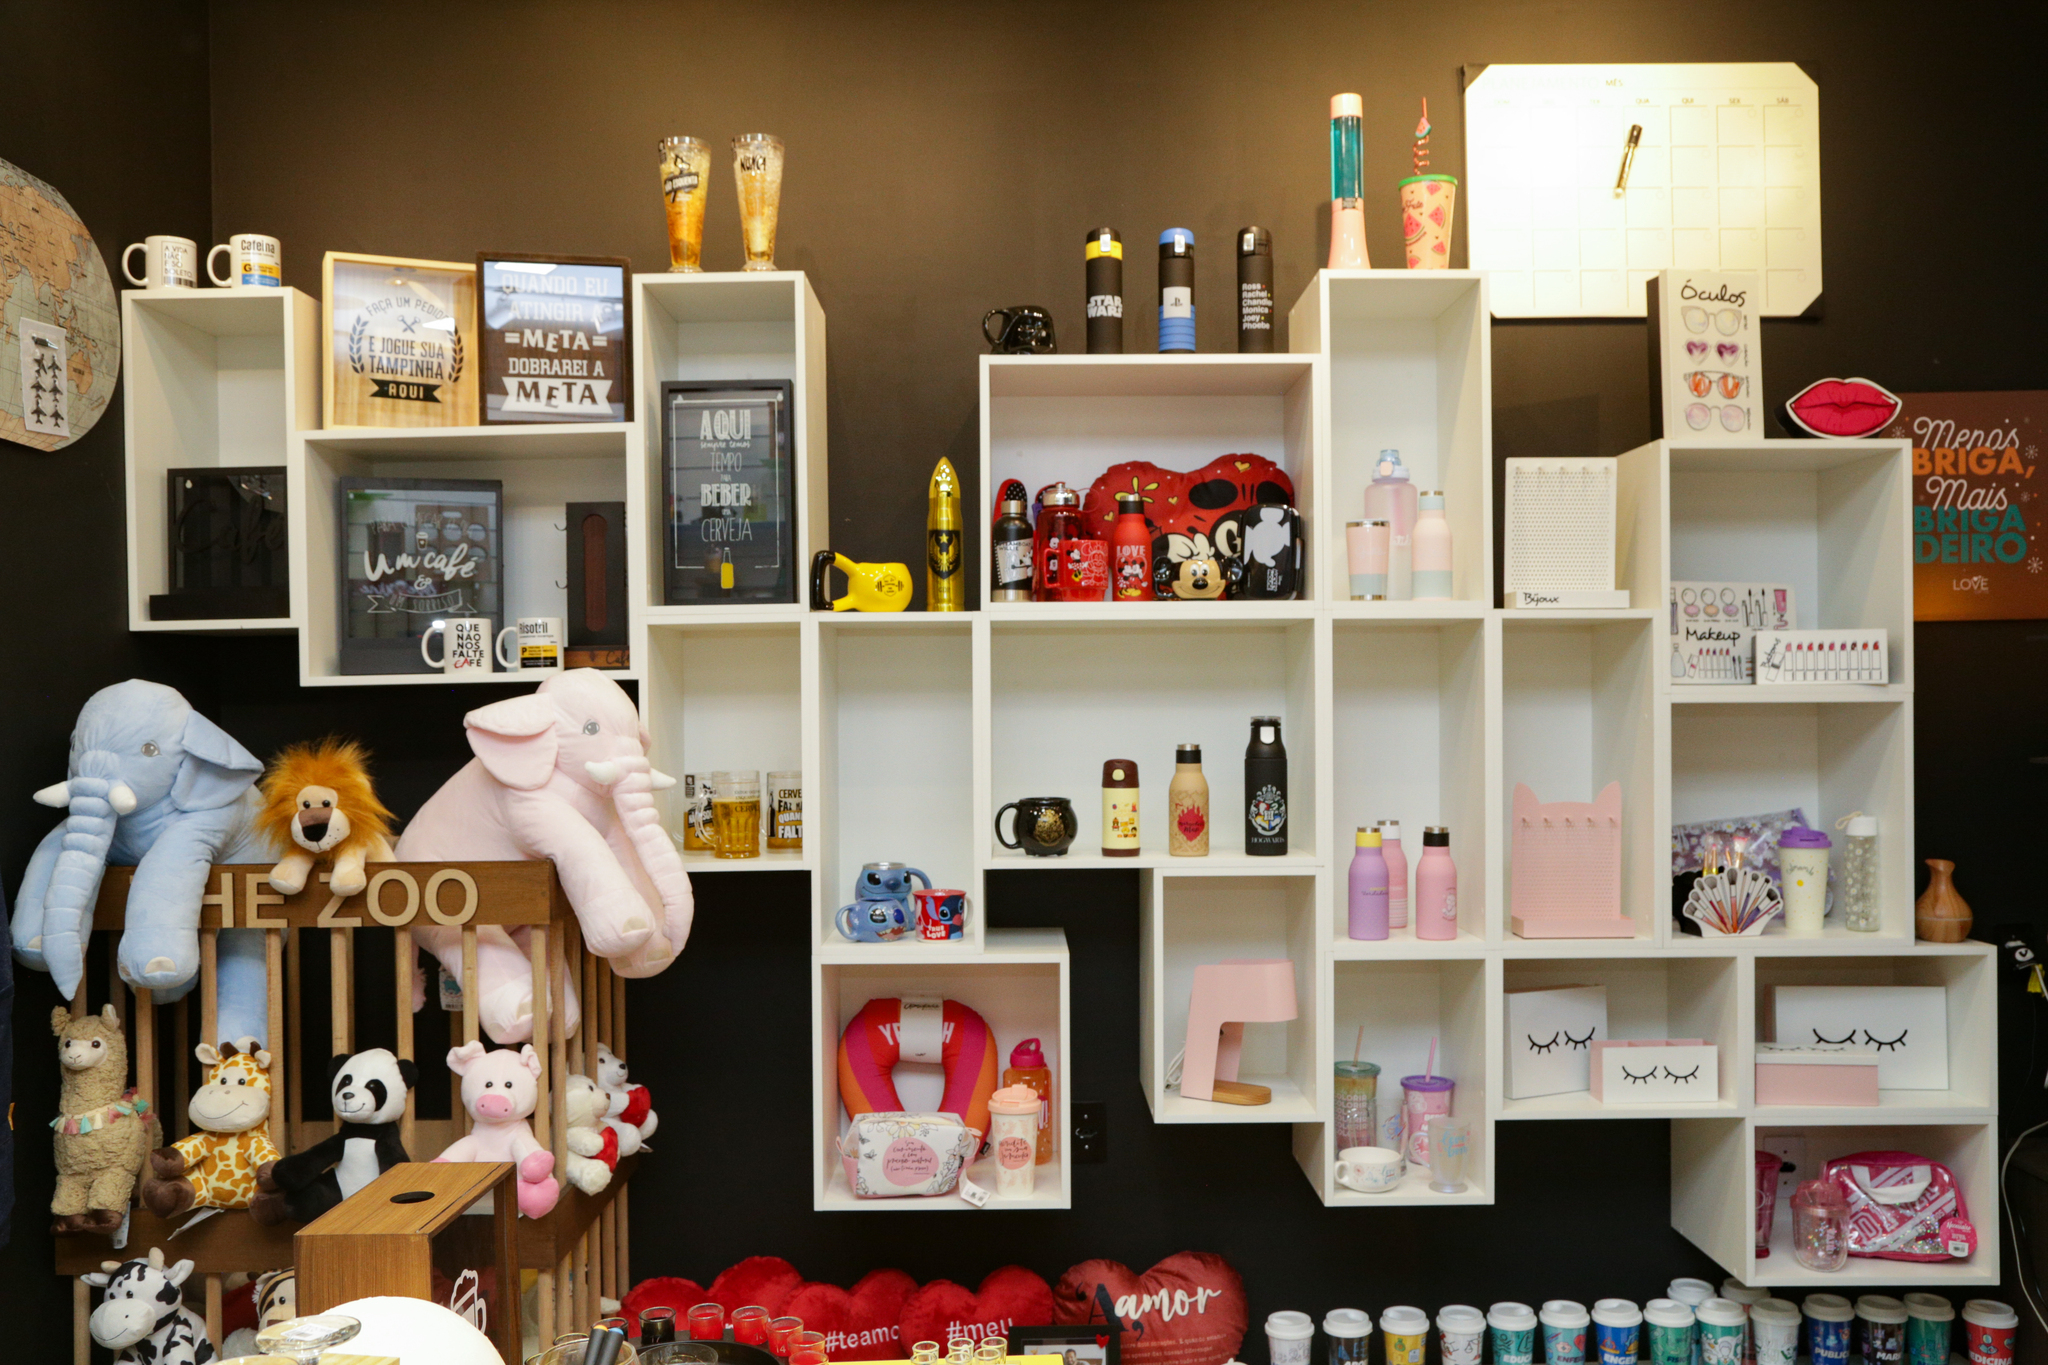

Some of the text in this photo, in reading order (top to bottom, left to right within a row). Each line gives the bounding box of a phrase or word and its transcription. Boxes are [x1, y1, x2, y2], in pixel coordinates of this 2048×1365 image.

[243, 263, 252, 272] G
[502, 273, 608, 296] QUANDO EU
[1242, 283, 1262, 291] Ross
[1242, 290, 1267, 299] Rachel
[1680, 279, 1748, 307] Óculos
[366, 298, 393, 316] FAÇA
[396, 297, 410, 307] UM
[1087, 304, 1122, 318] WARS
[1089, 295, 1122, 307] STAR
[1242, 306, 1269, 315] Monica
[510, 301, 584, 322] ATINGIR
[1242, 314, 1260, 322] Joey
[1242, 322, 1270, 331] Phoebe
[369, 336, 444, 359] E JOGUE SUA
[369, 355, 444, 380] TAMPINHA
[508, 357, 605, 377] DOBRAREI A
[389, 383, 424, 399] AQUI
[516, 380, 599, 409] META
[701, 409, 752, 441] AQUI
[1913, 416, 2020, 451] Menos
[710, 452, 742, 473] TEMPO
[1912, 446, 2036, 479] BRIGA,
[700, 483, 752, 507] BEBER
[1926, 476, 2008, 511] Mais
[1914, 504, 2027, 533] BRIGA
[701, 518, 753, 542] CERVEJA
[1116, 545, 1145, 557] LOVE
[1914, 532, 2028, 564] DEIRO
[423, 543, 478, 581] café
[1953, 576, 1989, 591] LOVE
[455, 624, 480, 633] QUE
[1685, 627, 1741, 647] Makeup
[452, 649, 484, 659] FALTE
[457, 641, 480, 650] NOS
[453, 657, 482, 669] CAFÉ
[201, 873, 288, 928] HE
[926, 930, 946, 939] LOVE
[1115, 1287, 1222, 1322] amor
